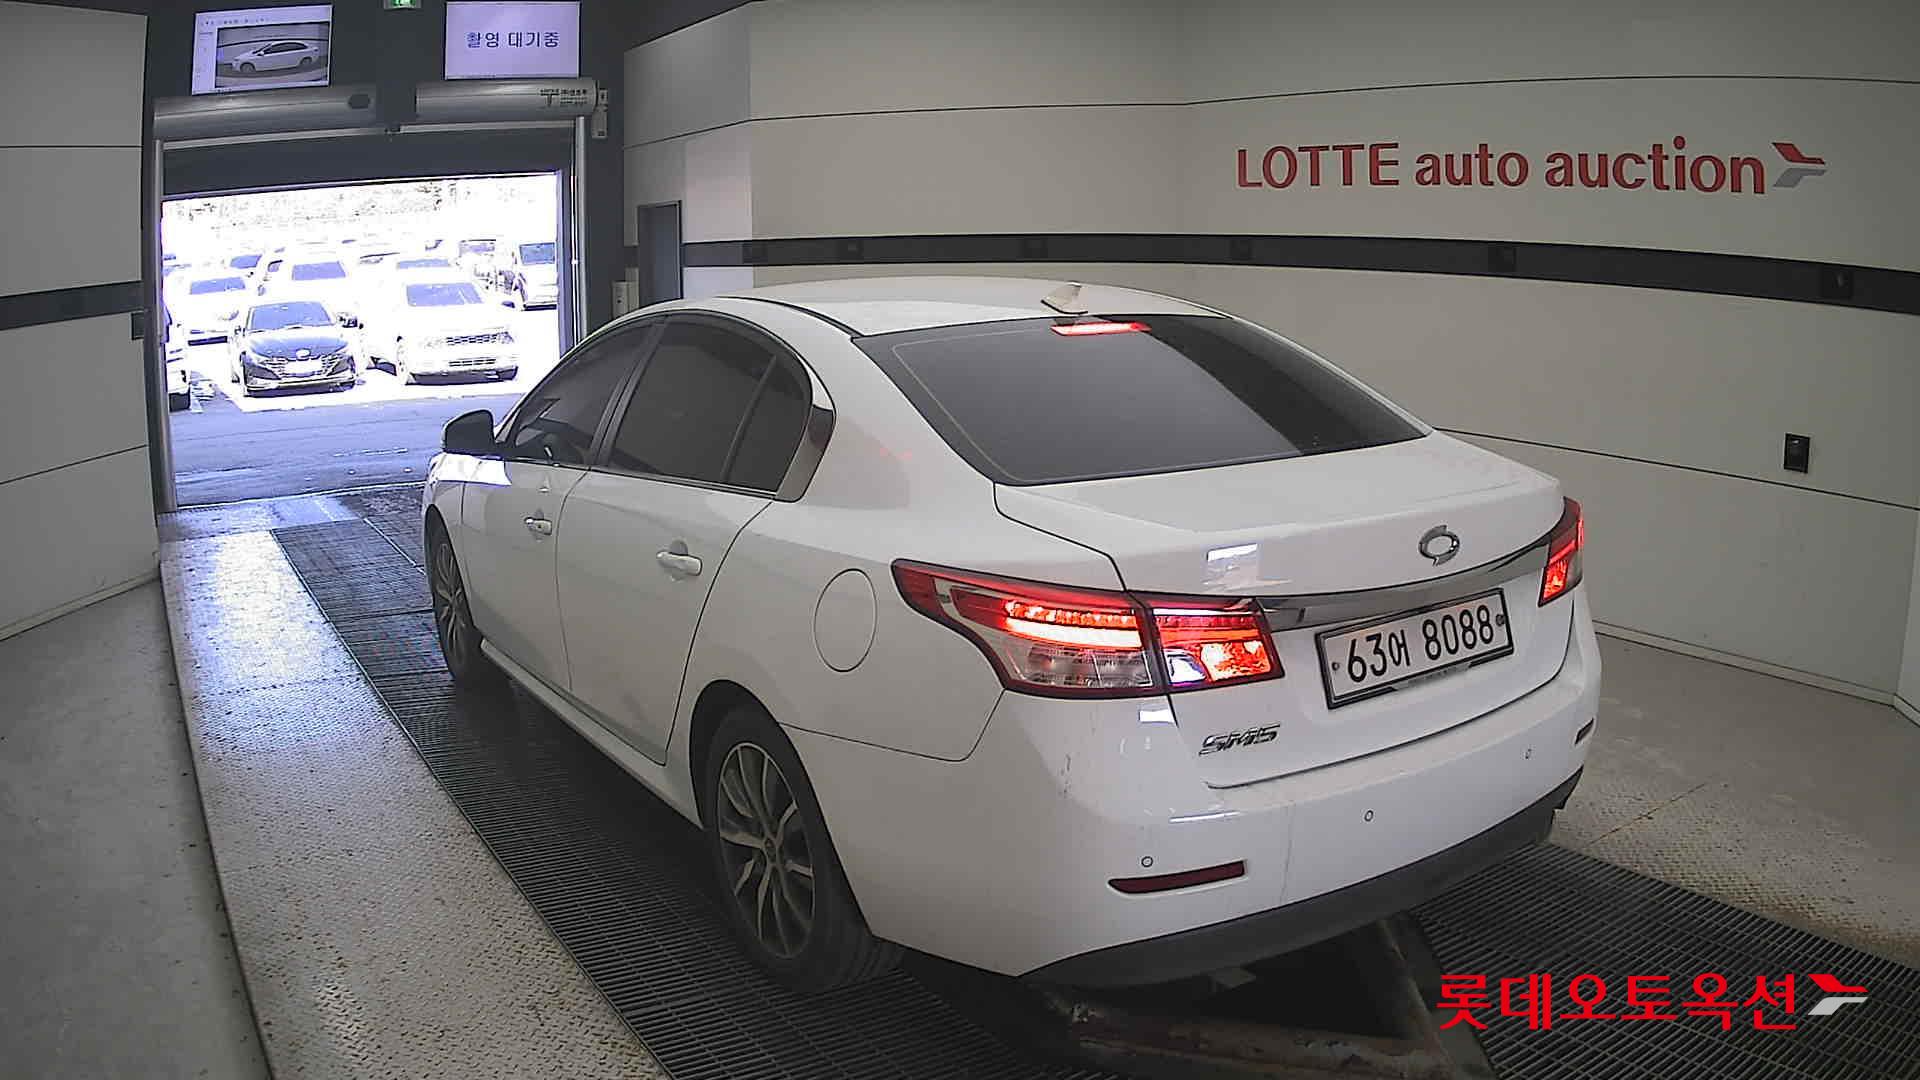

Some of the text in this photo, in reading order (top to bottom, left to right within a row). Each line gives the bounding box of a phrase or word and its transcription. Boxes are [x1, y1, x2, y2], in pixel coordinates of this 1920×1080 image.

[466, 31, 560, 49] 촬영 대기중
[1237, 135, 1766, 194] LOTTE auto auction
[1347, 629, 1411, 683] 63어
[1421, 604, 1495, 661] 8088
[1199, 723, 1281, 756] SM5
